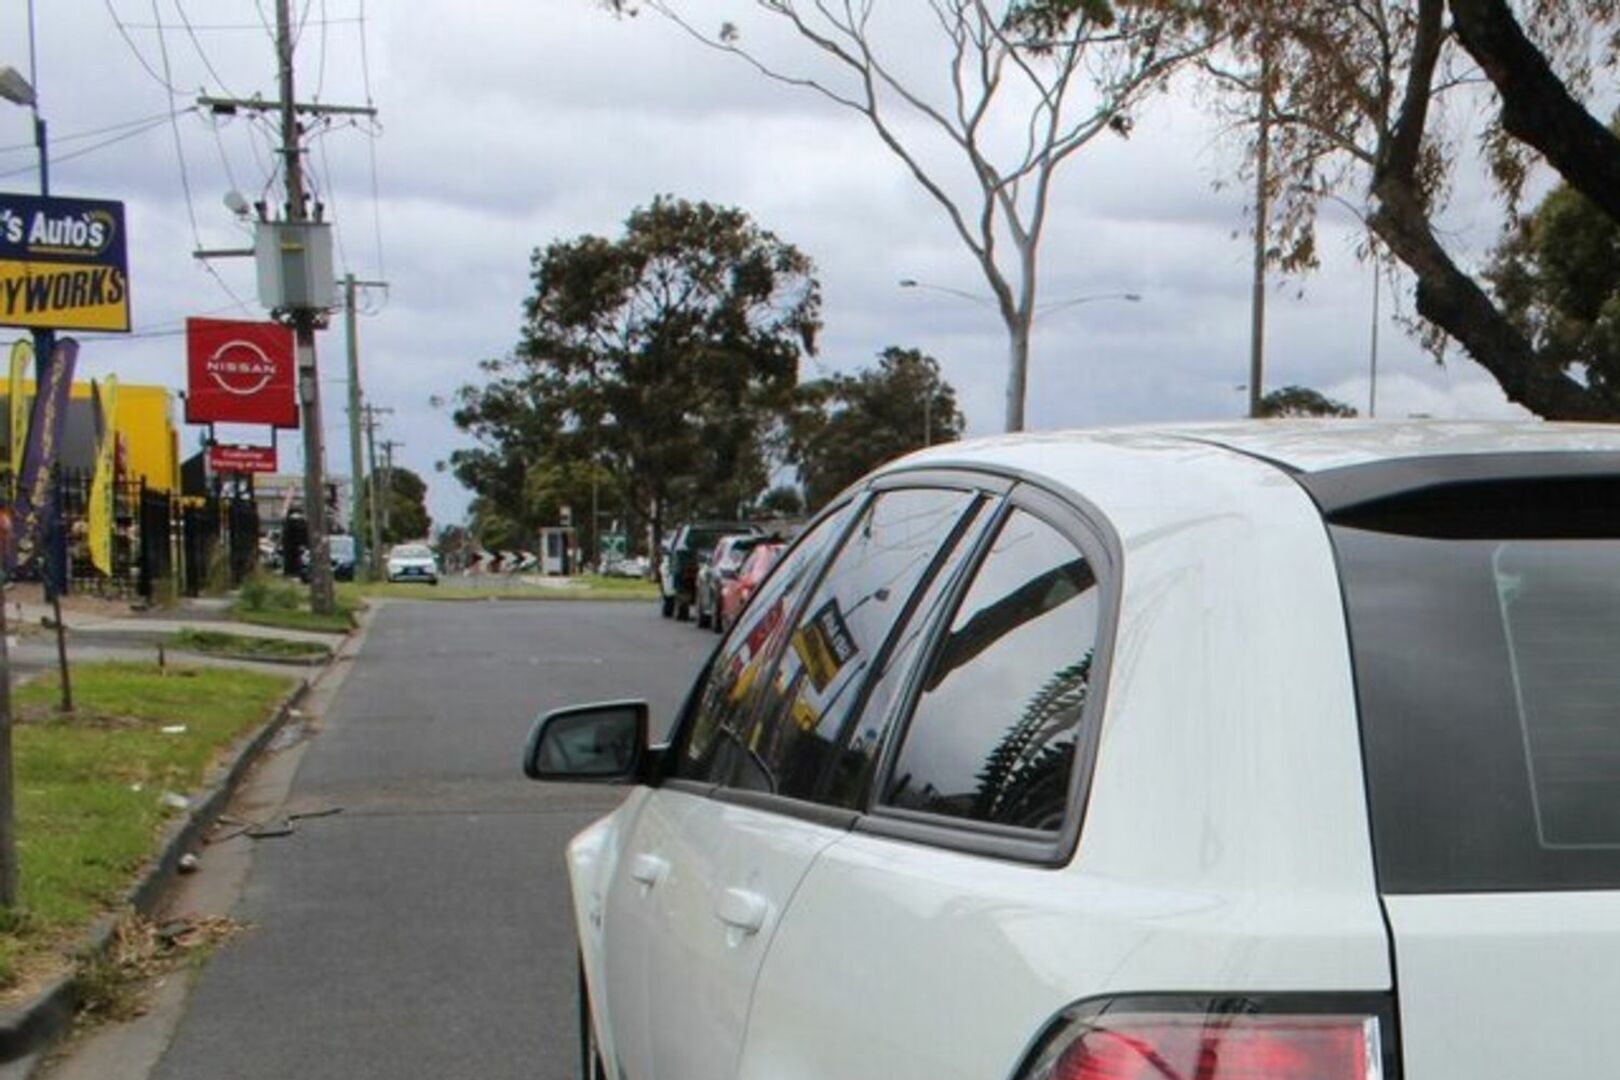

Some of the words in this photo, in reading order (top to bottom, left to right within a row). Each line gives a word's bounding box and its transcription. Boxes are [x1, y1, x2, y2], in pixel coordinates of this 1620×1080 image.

[28, 211, 105, 247] Auto's
[0, 267, 124, 316] YWORKS
[206, 361, 276, 374] NISSAN
